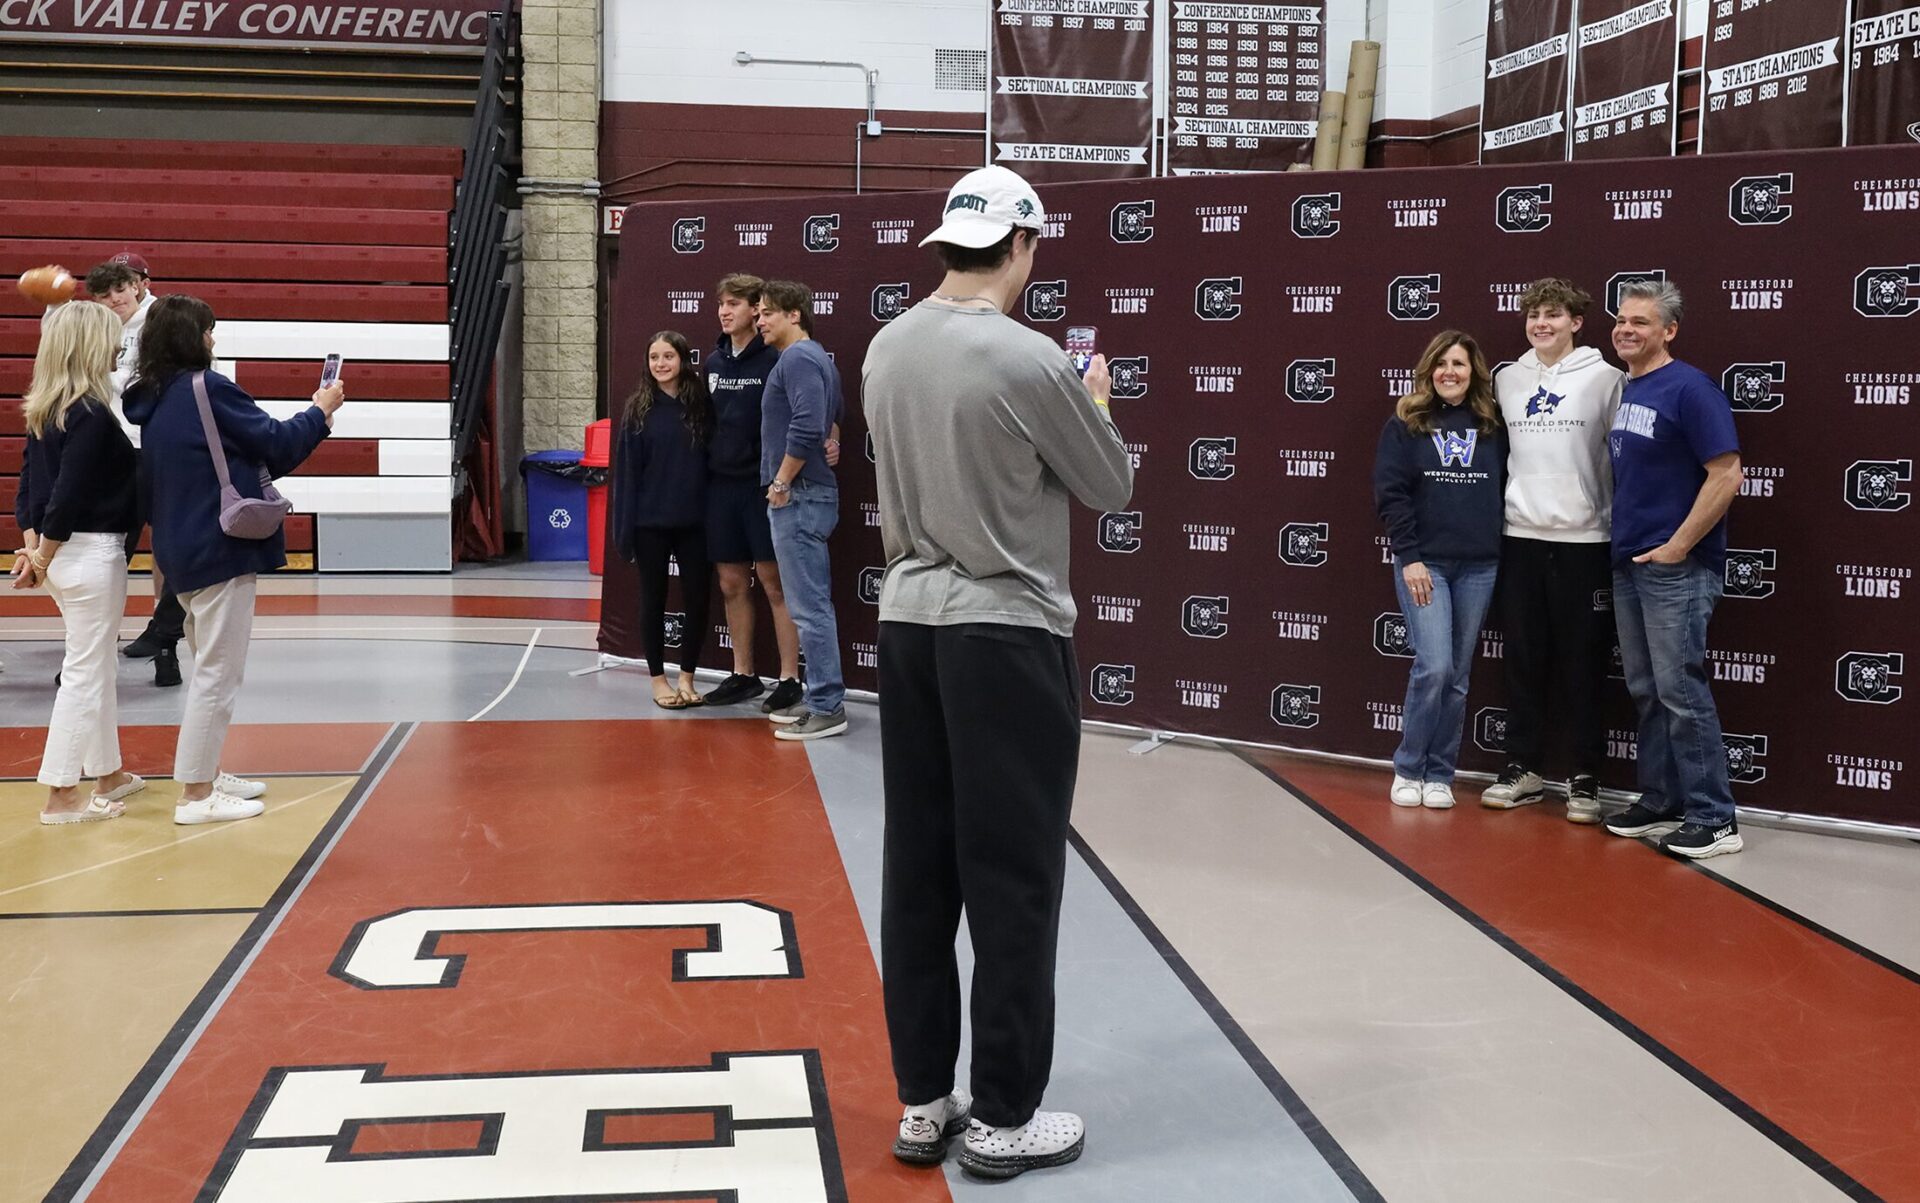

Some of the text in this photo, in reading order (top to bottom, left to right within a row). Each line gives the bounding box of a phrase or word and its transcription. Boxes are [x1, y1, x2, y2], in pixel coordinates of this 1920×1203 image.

[1008, 0, 1139, 15] CONFERENCE CHAMPIONS
[1184, 4, 1312, 22] CONFERENCE CHAMPIONS
[73, 0, 228, 32] VALLEY
[238, 3, 488, 40] CONFERENC
[1000, 14, 1146, 31] 1995 1996 1997 1998 2001
[1583, 1, 1667, 43] SECTIONAL CHAMPIONS
[1176, 21, 1319, 37] 1983 1984 1985 1986 1987
[1714, 23, 1733, 42] 1993
[1855, 14, 1904, 44] STATE
[1176, 37, 1198, 49] 1988
[1237, 40, 1258, 51] 1990
[1268, 41, 1287, 52] 1991
[1297, 42, 1319, 53] 1993
[1176, 54, 1319, 70] 1994 1996 1998 1999 2000
[1873, 43, 1900, 66] 1984
[1722, 65, 1757, 88] STATE
[1758, 45, 1824, 79] CHAMPIONS
[1177, 70, 1319, 86] 2001 2002 2003 2003 2005
[1787, 75, 1807, 95] 2012
[1008, 79, 1137, 96] SECTIONAL CHAMPIONS
[1176, 86, 1319, 102] 2006 2019 2020 2021 2023
[1177, 102, 1229, 115] 2024 2025
[1584, 89, 1656, 123] STATE CHAMPIONS
[1185, 119, 1310, 136] SECTIONAL CHAMPIONS
[1176, 135, 1259, 149] 1985 1986 2003
[1494, 127, 1517, 147] STATE
[1013, 145, 1130, 162] STATE CHAMPIONS
[1605, 189, 1673, 201] CHELMSFORD
[1863, 191, 1920, 211] LIONS
[1195, 205, 1248, 216] CHELMSFORD
[1387, 199, 1447, 209] CHELMSFORD
[1613, 201, 1663, 220] LIONS
[872, 220, 915, 229] CHELMSFORD
[1201, 216, 1240, 232] LIONS
[1394, 210, 1438, 227] LIONS
[734, 224, 773, 232] CHELMSFORD
[739, 232, 768, 246] LIONS
[877, 229, 909, 244] LIONS
[1105, 288, 1154, 297] CHELMSFORD
[1286, 286, 1342, 296] CHELMSFORD
[1722, 279, 1793, 290] CHELMSFORD
[667, 291, 704, 299] CHELMSFORD
[1730, 291, 1783, 310] LIONS
[672, 300, 700, 314] LIONS
[812, 301, 833, 315] ONS
[1111, 298, 1147, 314] LIONS
[1292, 296, 1333, 313] LIONS
[1189, 366, 1242, 376] CHELMSFORD
[1845, 373, 1920, 384] CHELMSFORD
[737, 378, 762, 386] REGINA
[1195, 377, 1234, 393] LIONS
[1854, 385, 1910, 405] LIONS
[1280, 450, 1335, 460] CHELMSFORD
[1286, 460, 1327, 477] LIONS
[1424, 471, 1466, 479] WESTFIELD
[1183, 524, 1236, 535] CHELMSFORD
[1189, 535, 1228, 552] LIONS
[1836, 564, 1912, 578] CHELMSFORD
[1845, 577, 1900, 598] LIONS
[1092, 595, 1141, 607] CHELMSFORD
[1097, 606, 1133, 623] LIONS
[1273, 611, 1328, 624] CHELMSFORD
[1279, 622, 1320, 640] LIONS
[1705, 650, 1776, 664] CHELMSFORD
[1713, 661, 1766, 684] LIONS
[1176, 680, 1228, 693] CHELMSFORD
[1182, 691, 1220, 708] LIONS
[1827, 754, 1903, 771] CHELMSFORD
[1836, 766, 1892, 790] LIONS
[1712, 825, 1734, 842] HOKA
